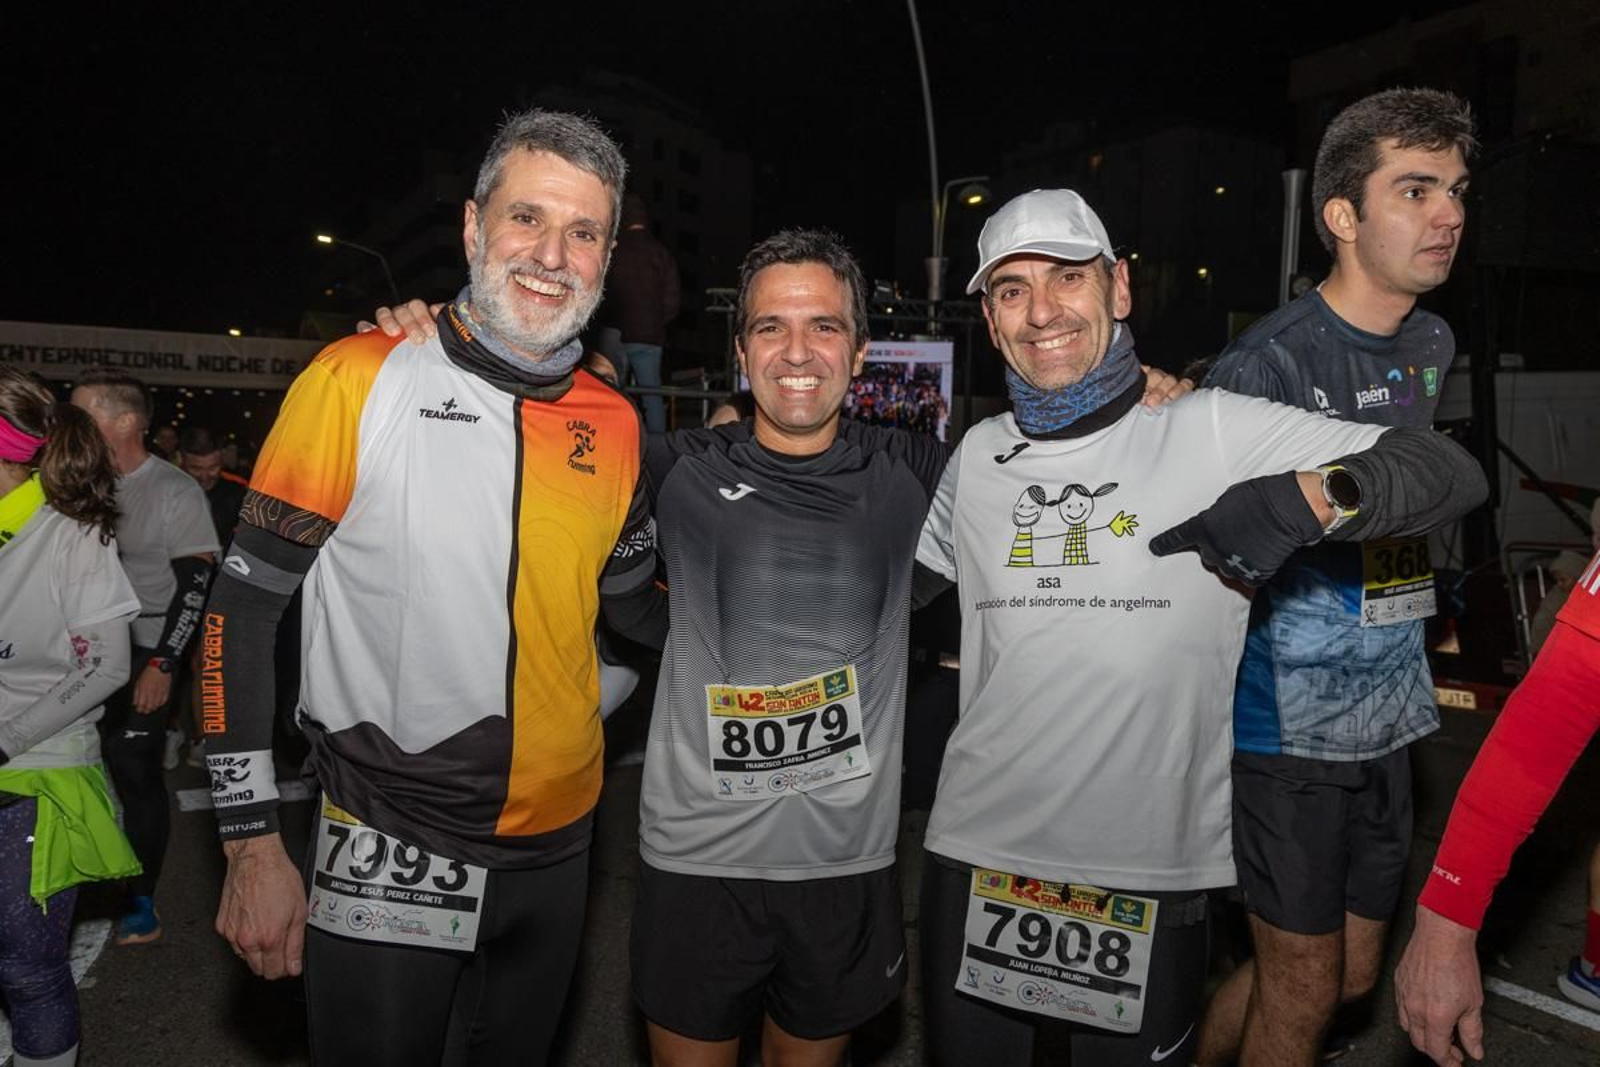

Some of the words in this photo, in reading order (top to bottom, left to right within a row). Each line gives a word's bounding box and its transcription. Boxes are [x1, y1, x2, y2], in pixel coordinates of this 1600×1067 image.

[197, 354, 260, 375] NOCHE
[272, 358, 298, 376] DE
[419, 408, 481, 424] TEAMERGY
[566, 420, 597, 437] CABRA
[1036, 576, 1062, 588] asa
[1009, 595, 1026, 608] del
[1029, 595, 1086, 609] síndrome
[1089, 595, 1106, 608] de
[1109, 597, 1171, 611] angelman
[722, 703, 849, 759] 8079
[745, 760, 782, 769] FRANCISCO
[325, 824, 469, 892] 7993
[360, 885, 385, 897] JESUS
[386, 889, 411, 901] PEREZ
[983, 902, 1132, 977] 7908
[1009, 959, 1029, 971] JUAN
